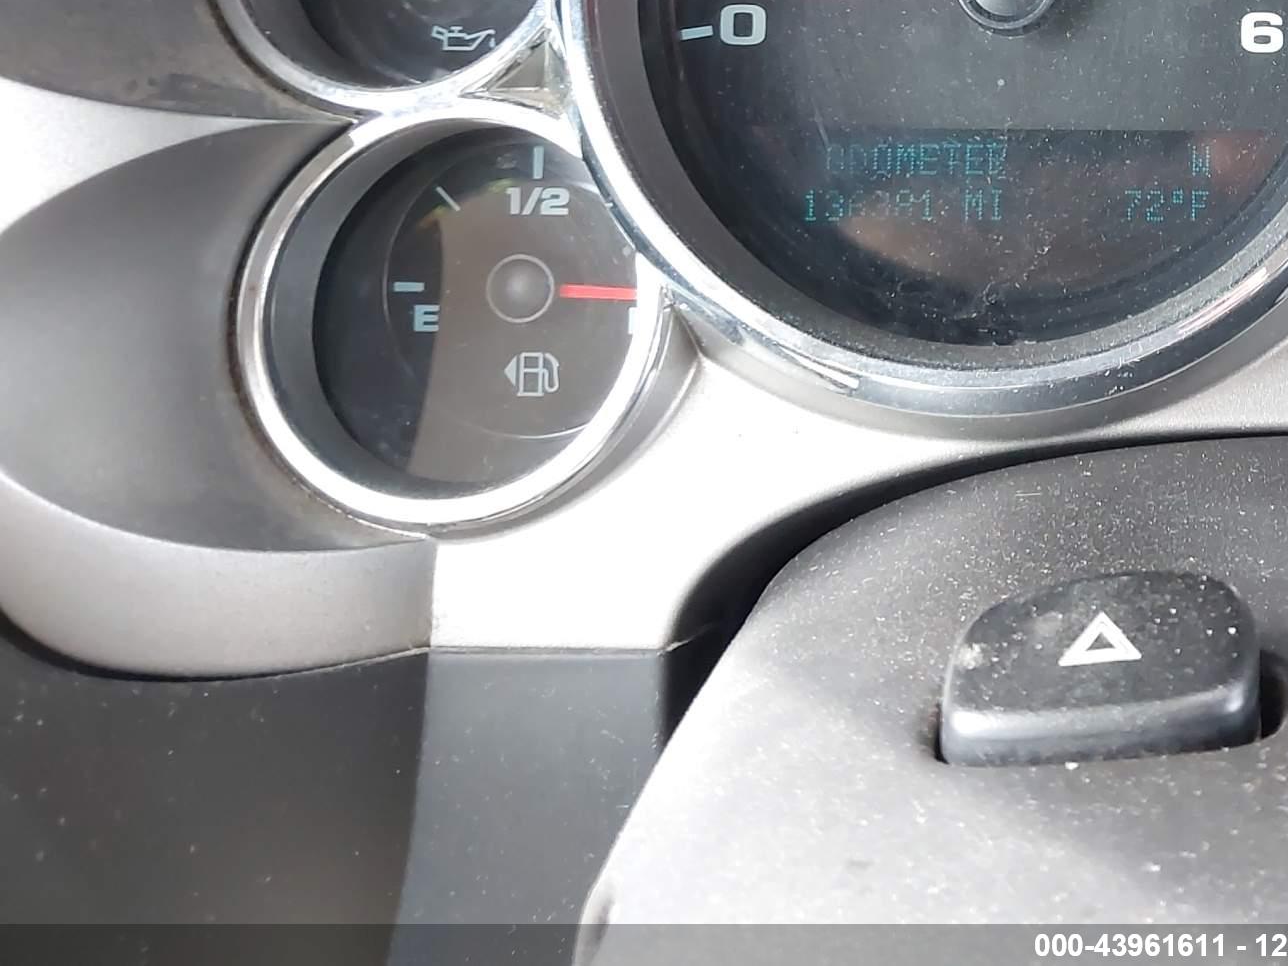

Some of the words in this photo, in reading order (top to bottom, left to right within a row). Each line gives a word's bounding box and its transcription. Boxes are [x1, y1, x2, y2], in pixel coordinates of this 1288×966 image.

[719, 4, 767, 45] 0
[1240, 12, 1284, 54] 6
[506, 187, 570, 216] 1/2
[964, 189, 1003, 222] MI
[413, 304, 439, 333] E
